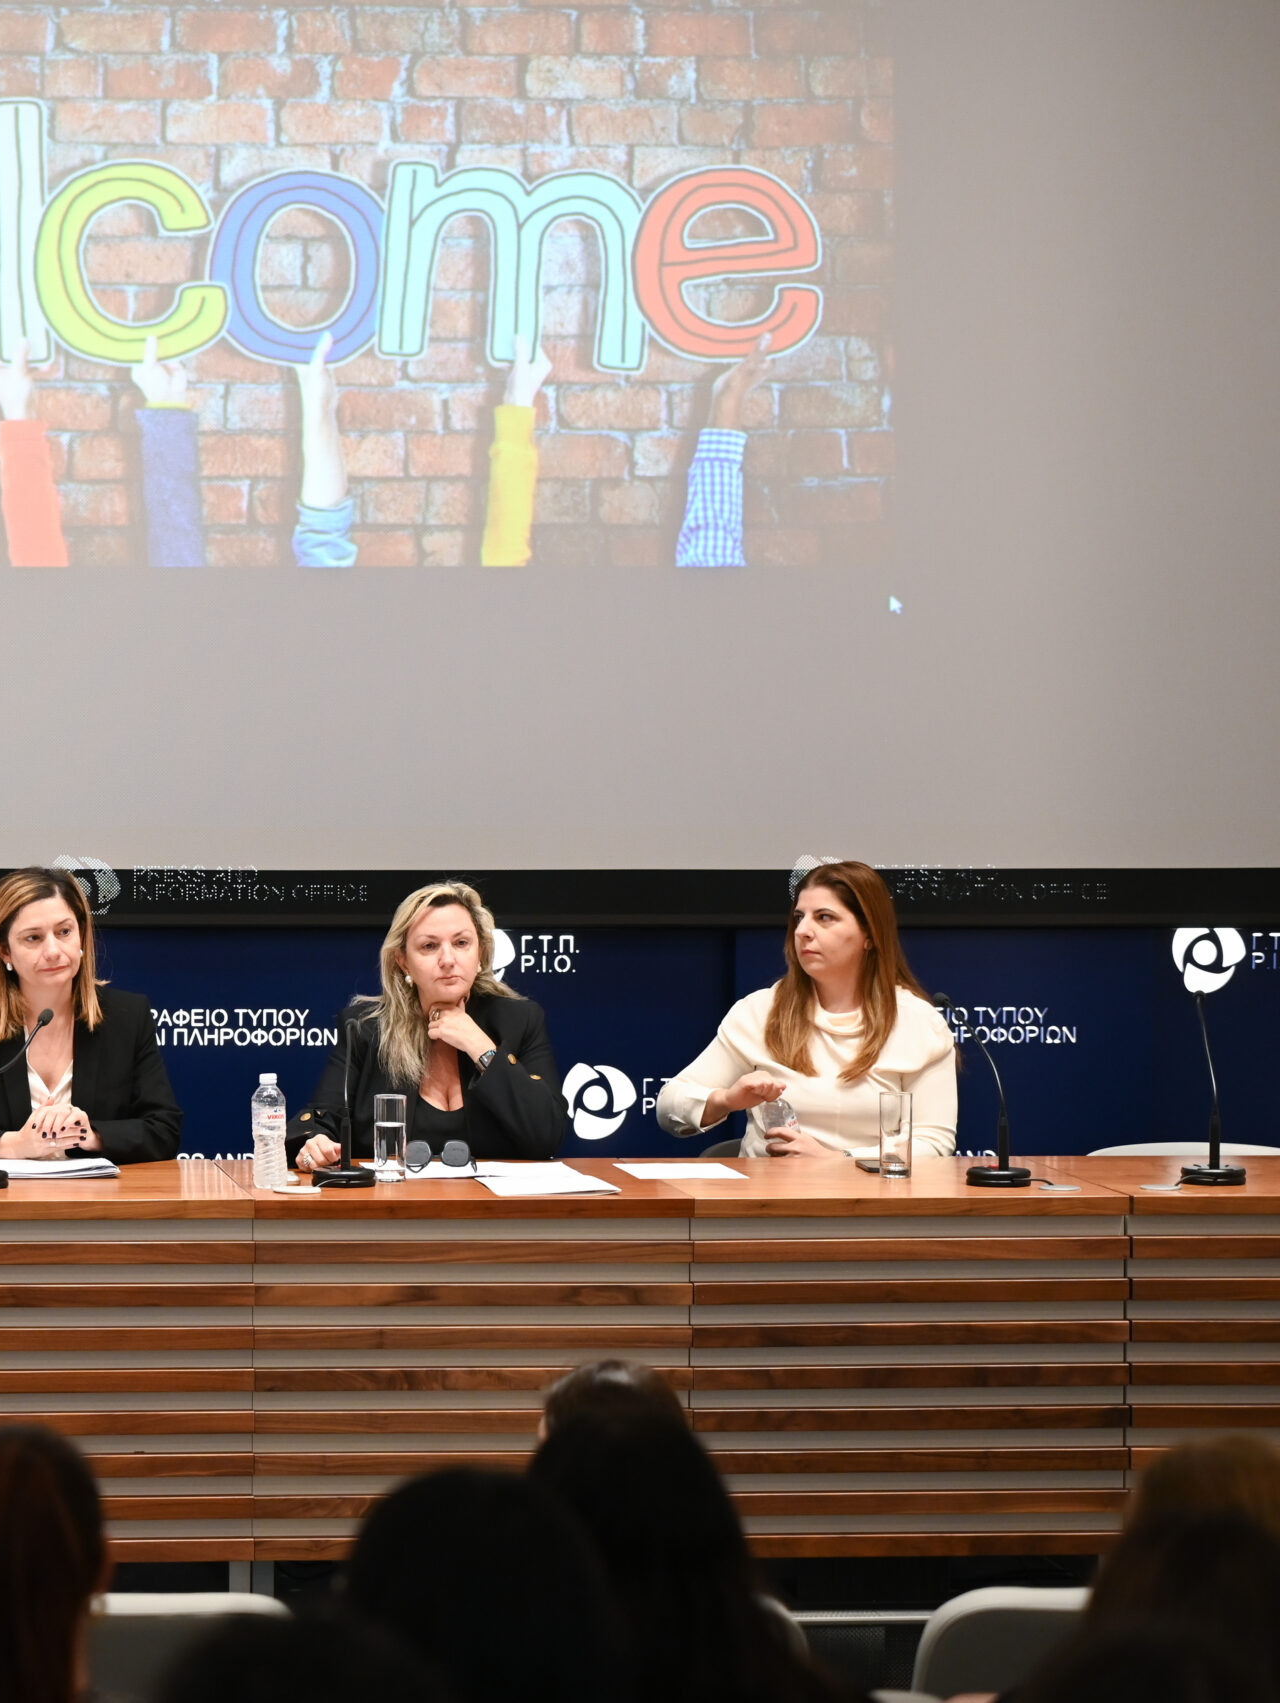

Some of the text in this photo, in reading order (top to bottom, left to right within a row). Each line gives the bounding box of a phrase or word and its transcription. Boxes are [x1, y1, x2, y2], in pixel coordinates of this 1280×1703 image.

[521, 934, 580, 954] Γ.Τ.Π.
[521, 954, 576, 973] P.I.O.
[150, 1008, 310, 1027] ΑΦΕΙΟ ΤΥΠΟΥ
[973, 1006, 1049, 1025] ΤΥΠΟΥ
[173, 1027, 338, 1046] ΠΛΗΡΟΦΟΡΙΩΝ
